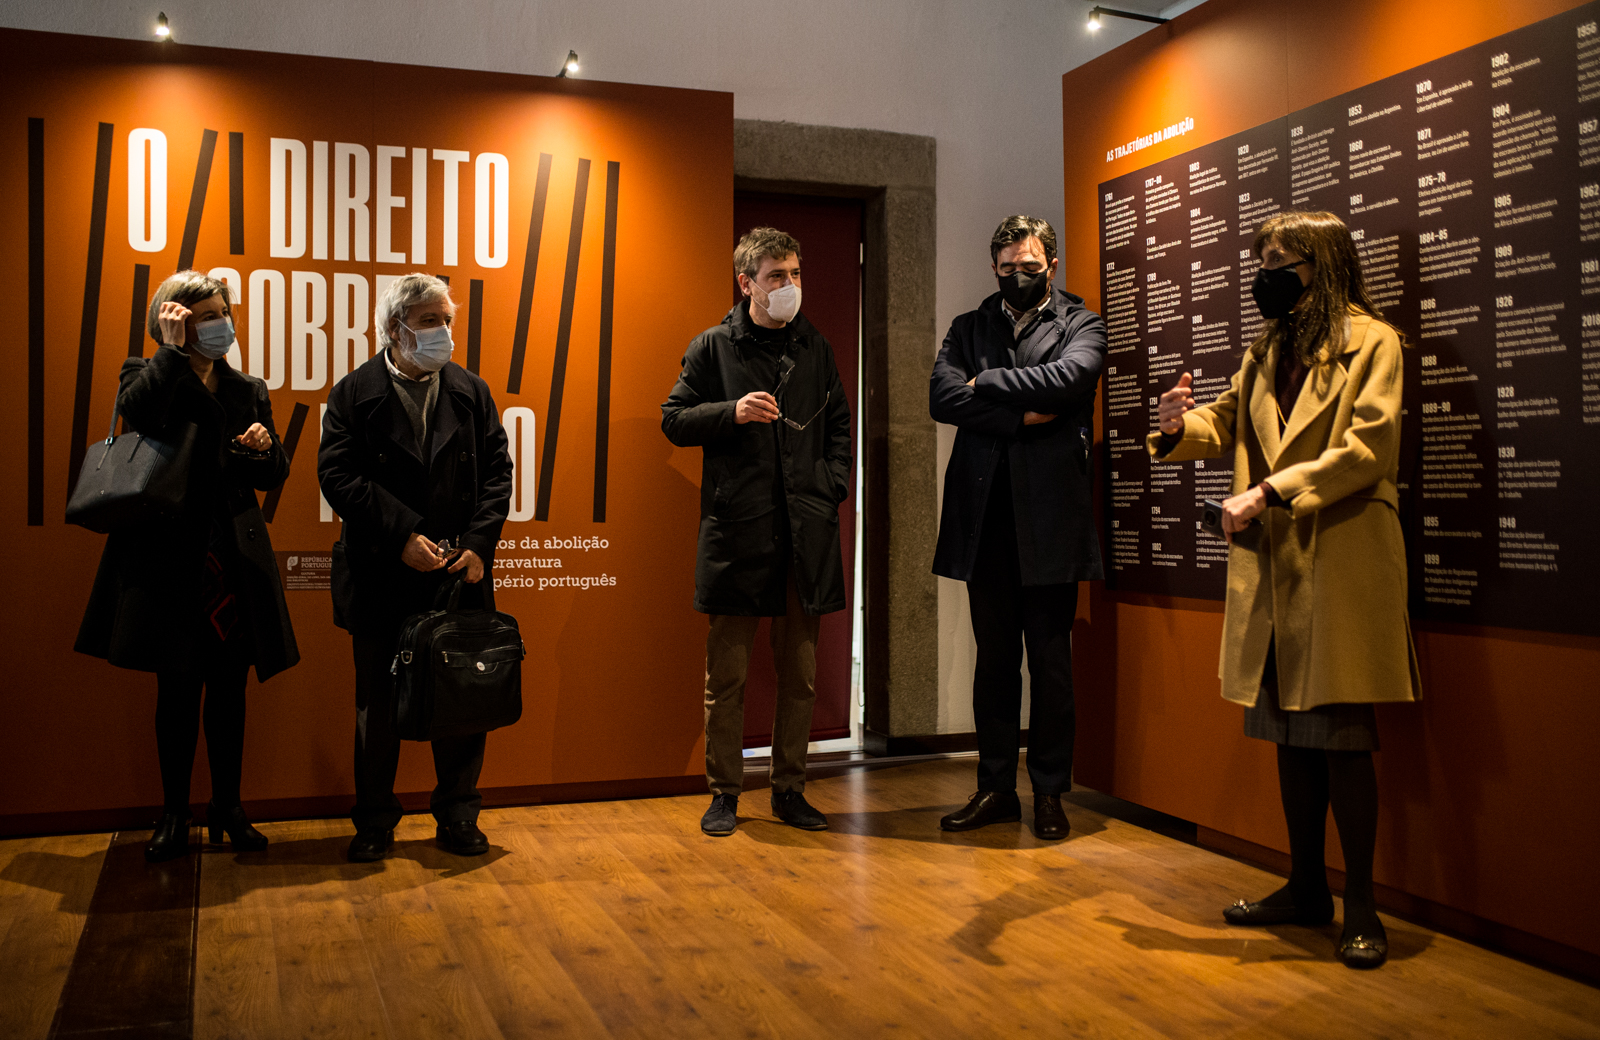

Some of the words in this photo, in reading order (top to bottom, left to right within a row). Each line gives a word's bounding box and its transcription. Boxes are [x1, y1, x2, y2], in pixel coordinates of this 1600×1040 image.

[1491, 52, 1509, 69] 1902
[1416, 80, 1432, 95] 1870
[1348, 104, 1362, 118] 1853
[1492, 103, 1510, 119] 1904
[1291, 126, 1304, 138] 1839
[1578, 119, 1598, 135] 1957
[1106, 150, 1114, 162] AS
[1114, 136, 1152, 159] TRAJETÓRIAS
[1153, 130, 1162, 144] DA
[1163, 117, 1194, 140] ABOLIÇÃO
[1417, 128, 1432, 142] 1871
[1349, 140, 1363, 153] 1860
[1418, 172, 1446, 189] 1875–78
[128, 128, 168, 252] O
[270, 137, 509, 268] DIREITO
[1580, 184, 1600, 198] 1962
[1350, 194, 1363, 206] 1861
[1494, 194, 1512, 209] 1905
[1351, 230, 1365, 242] 1862
[1419, 230, 1448, 245] 1884–85
[1240, 248, 1250, 260] 1831
[1494, 245, 1513, 259] 1909
[1580, 260, 1599, 274] 1981
[1420, 298, 1436, 310] 1886
[1496, 295, 1513, 309] 1926
[207, 267, 401, 391] OBR
[1421, 356, 1437, 367] 1888
[1497, 386, 1515, 398] 1928
[1422, 402, 1451, 414] 1889–90
[1498, 447, 1516, 458] 1930
[1195, 460, 1204, 469] 1815
[1424, 517, 1439, 526] 1895
[1499, 518, 1516, 528] 1948
[520, 536, 540, 550] da
[544, 536, 610, 552] abolição
[1424, 554, 1440, 565] 1899
[538, 573, 617, 590] português
